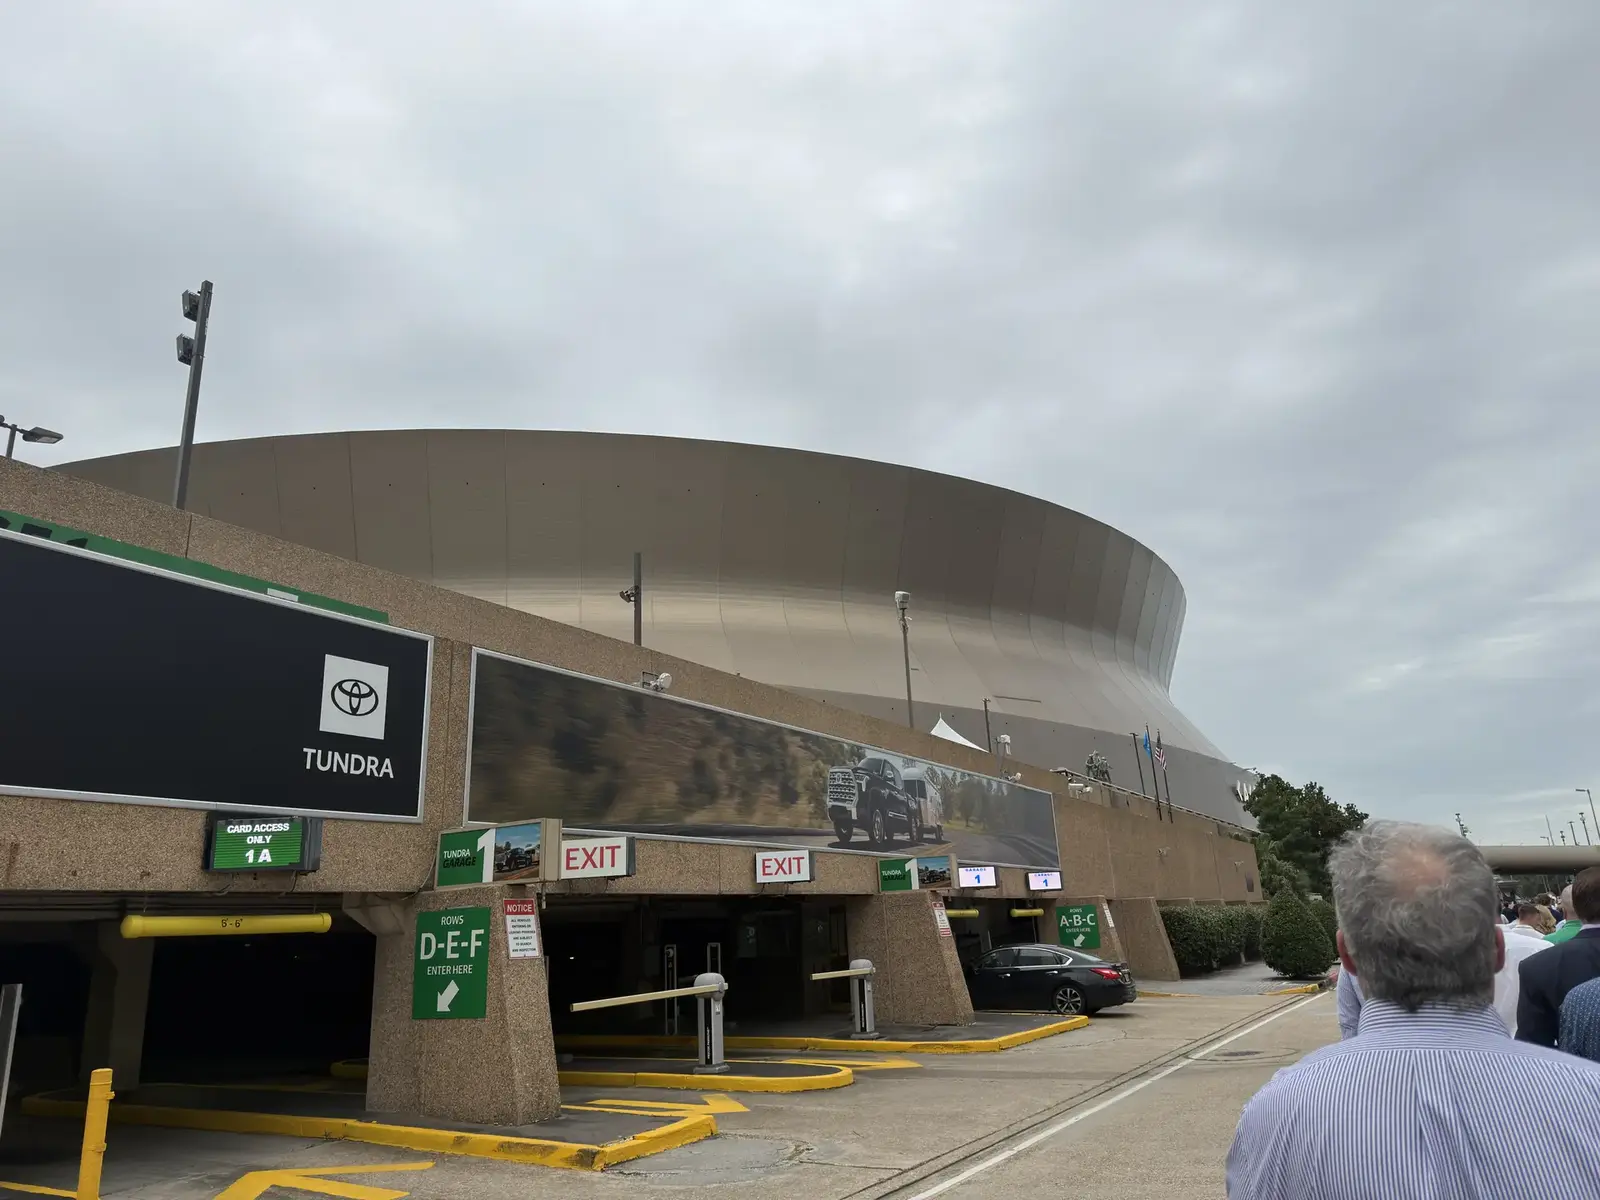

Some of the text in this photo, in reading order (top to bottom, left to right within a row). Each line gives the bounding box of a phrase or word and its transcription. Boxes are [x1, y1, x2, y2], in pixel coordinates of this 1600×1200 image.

[303, 747, 394, 778] TUNDRA
[227, 823, 290, 833] CARD ACCESS
[246, 835, 272, 844] ONLY
[443, 849, 471, 859] TUNDRA
[476, 828, 496, 883] 1
[565, 845, 621, 871] EXIT
[442, 857, 477, 869] GARAGE
[761, 856, 805, 877] EXIT
[974, 874, 981, 884] 1
[1043, 879, 1049, 887] 1
[507, 904, 533, 912] NOTICE
[441, 915, 464, 926] ROWS
[1060, 913, 1096, 927] A-B-C
[420, 929, 485, 960] D-E-F
[427, 964, 473, 975] ENTER HERE
